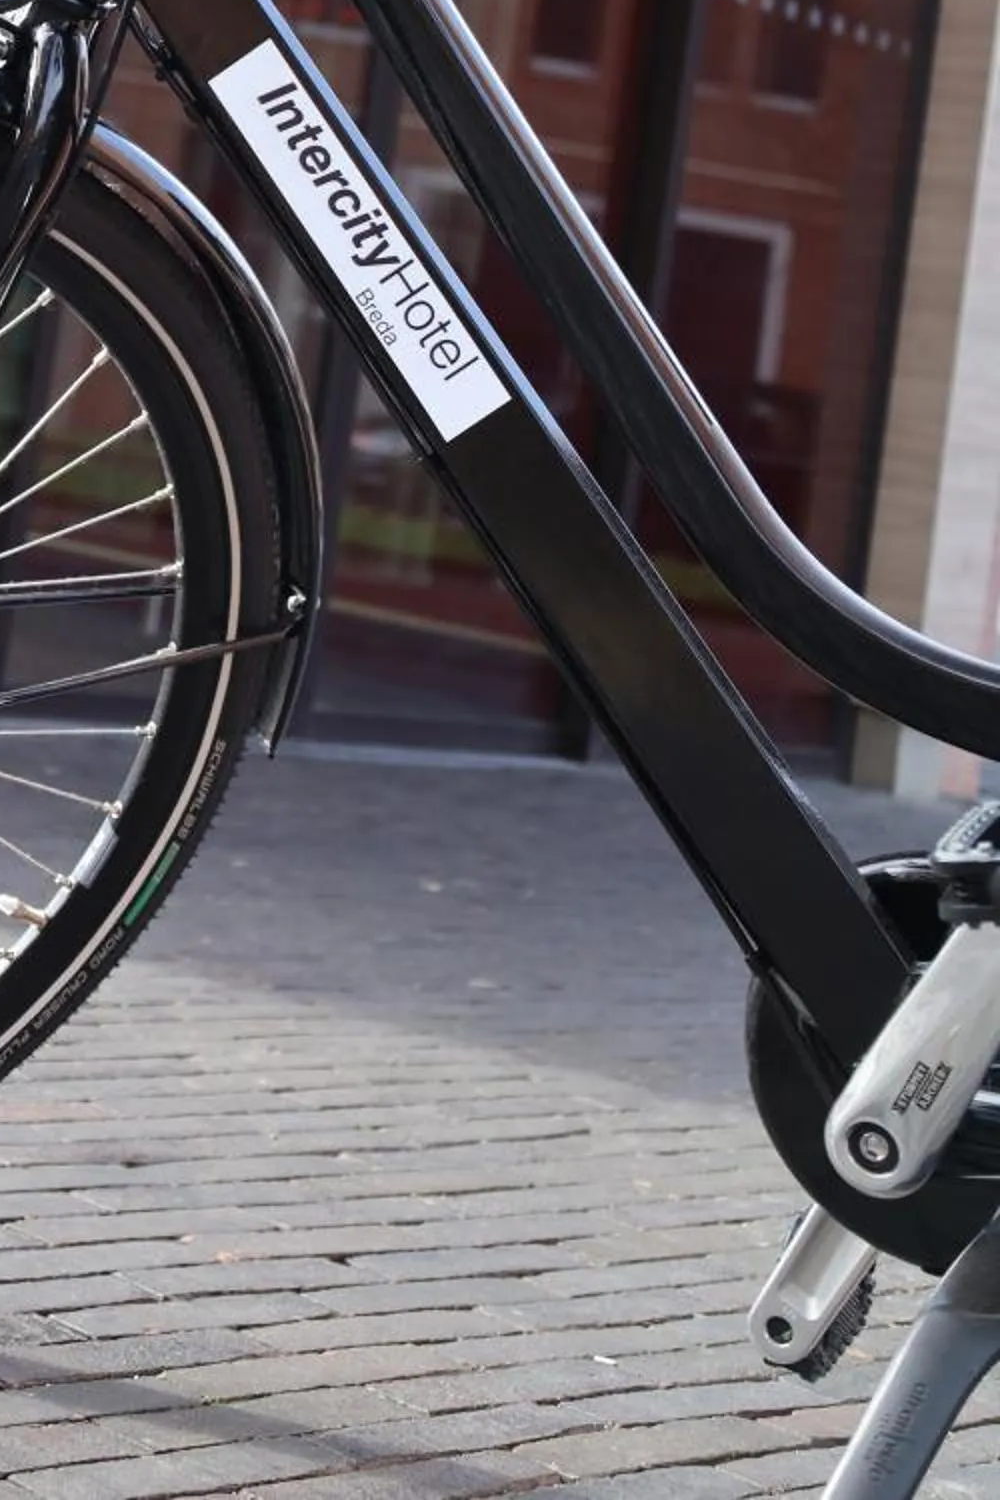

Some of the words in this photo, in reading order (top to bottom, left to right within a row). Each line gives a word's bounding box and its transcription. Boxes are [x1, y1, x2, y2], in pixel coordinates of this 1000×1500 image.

[257, 82, 479, 381] IntercityHotel
[355, 288, 397, 347] Breda
[177, 739, 227, 840] SCHWALBE
[86, 925, 126, 970] ROAD
[30, 969, 90, 1030] CRUISER
